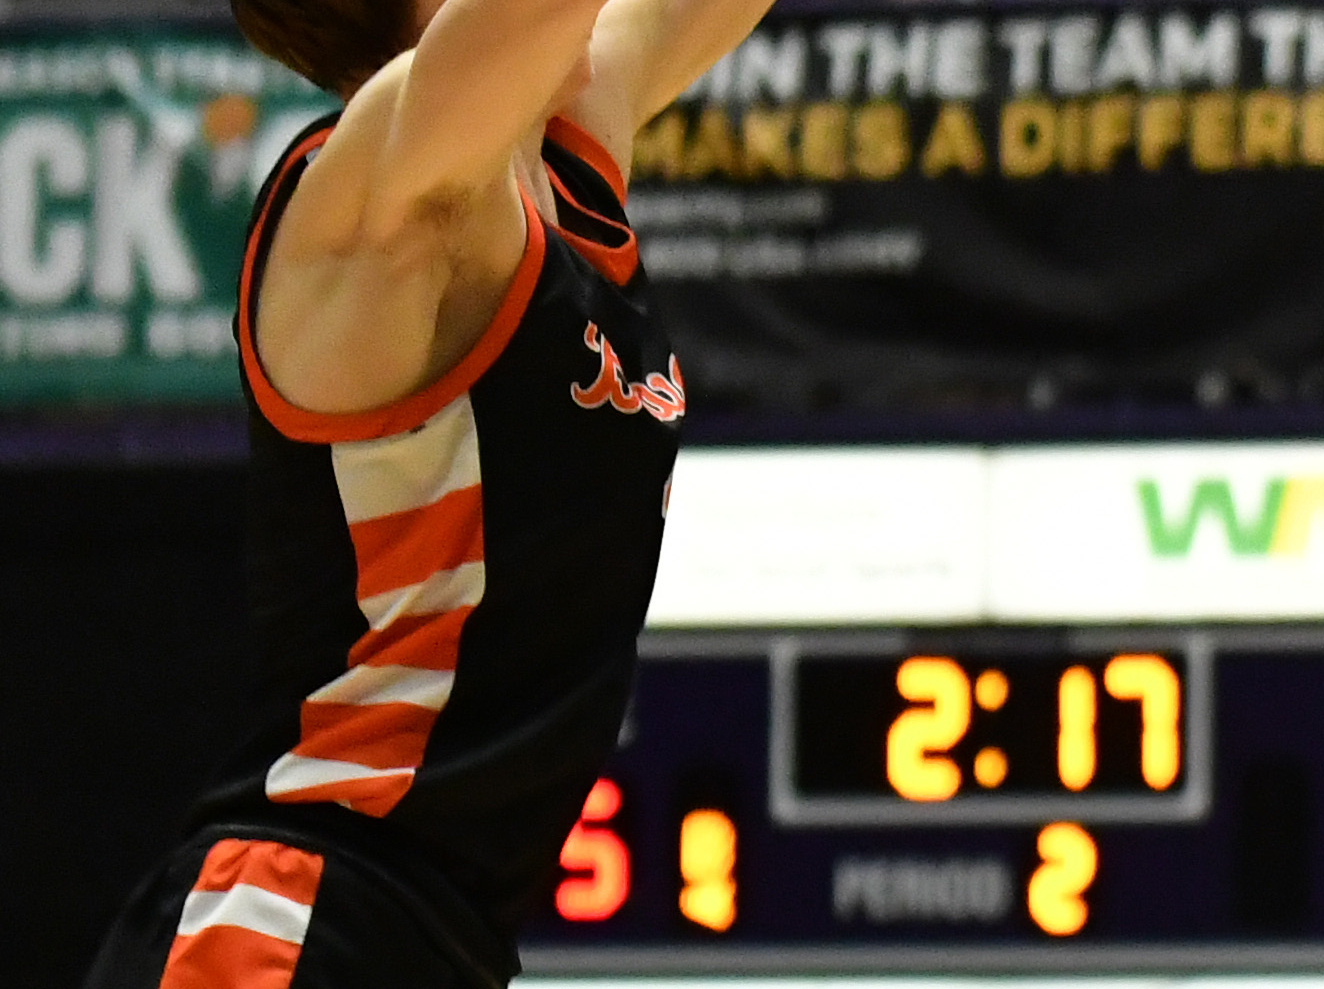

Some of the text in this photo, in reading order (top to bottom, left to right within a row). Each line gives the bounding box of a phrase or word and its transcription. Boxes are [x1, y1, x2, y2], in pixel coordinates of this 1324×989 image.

[818, 20, 984, 100] THE
[1002, 14, 1241, 93] TEAM
[920, 102, 986, 180] A
[887, 653, 1181, 801] 2:17
[832, 852, 1014, 925] PERIOD
[1027, 820, 1099, 937] 2
